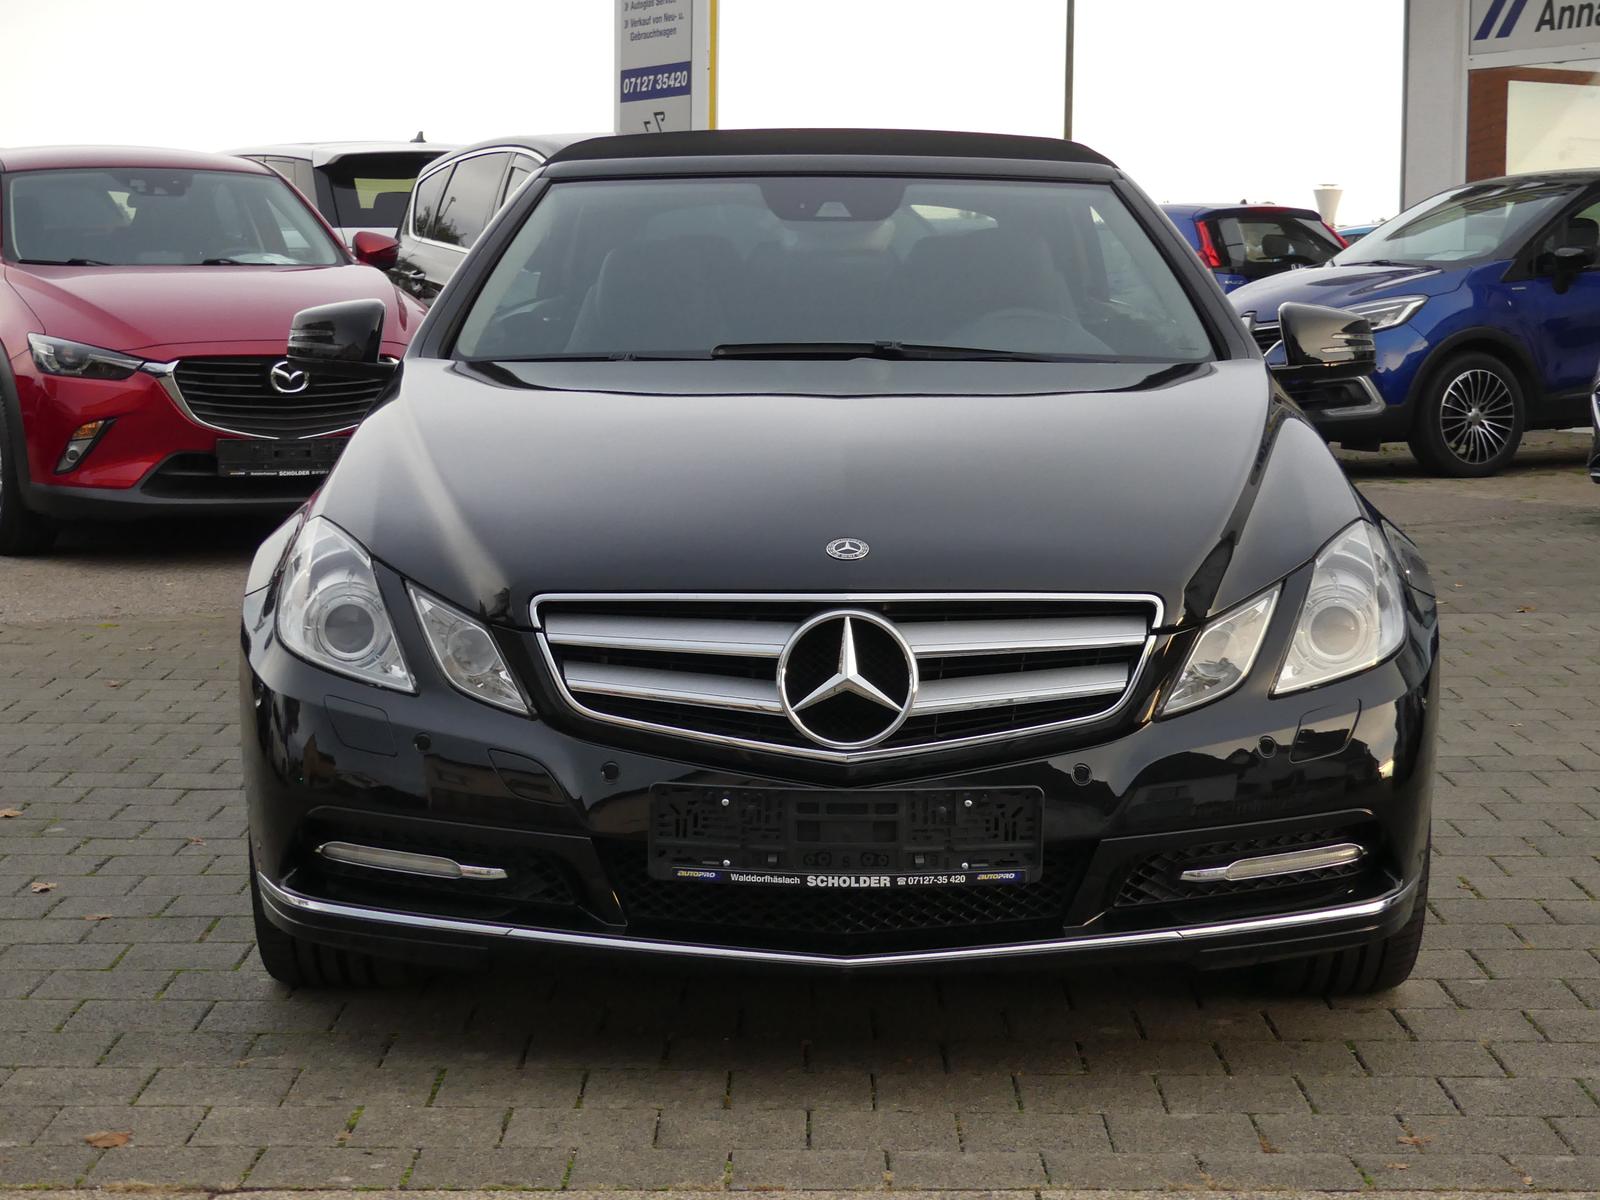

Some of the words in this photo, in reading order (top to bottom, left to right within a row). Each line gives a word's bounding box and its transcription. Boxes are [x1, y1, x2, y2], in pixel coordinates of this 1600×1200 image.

[630, 16, 651, 28] Verkauf
[652, 16, 662, 24] von
[630, 27, 677, 41] Gebrauchtwagen
[623, 75, 654, 94] 07127
[656, 70, 688, 89] 35420
[730, 873, 800, 884] Walddorfhäslach
[806, 875, 891, 887] SCHOLDER
[908, 875, 948, 885] 07127-35
[949, 875, 966, 883] 420
